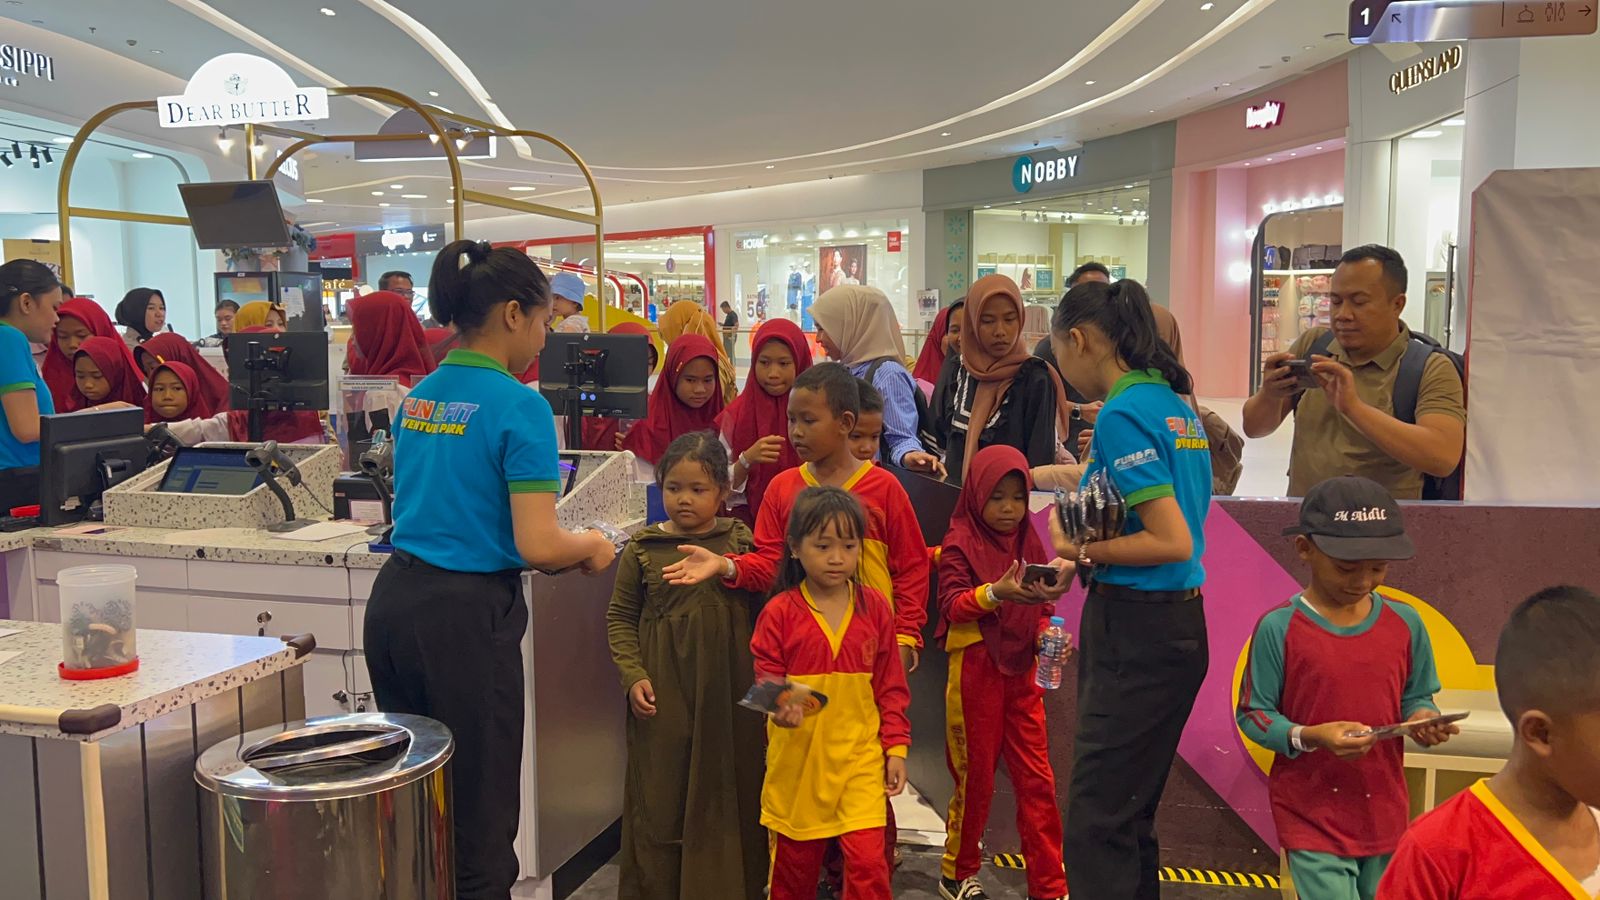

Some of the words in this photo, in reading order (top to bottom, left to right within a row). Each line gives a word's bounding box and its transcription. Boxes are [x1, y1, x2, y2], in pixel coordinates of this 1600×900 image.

[1360, 7, 1370, 26] 1
[0, 44, 54, 82] SIPPI
[1389, 45, 1462, 95] QUEENSLAND
[167, 102, 223, 124] DEAR
[230, 94, 312, 119] BUTTER
[1021, 155, 1078, 185] NOBBY
[321, 279, 345, 290] afé
[403, 397, 435, 420] FUN
[443, 402, 480, 423] FIT
